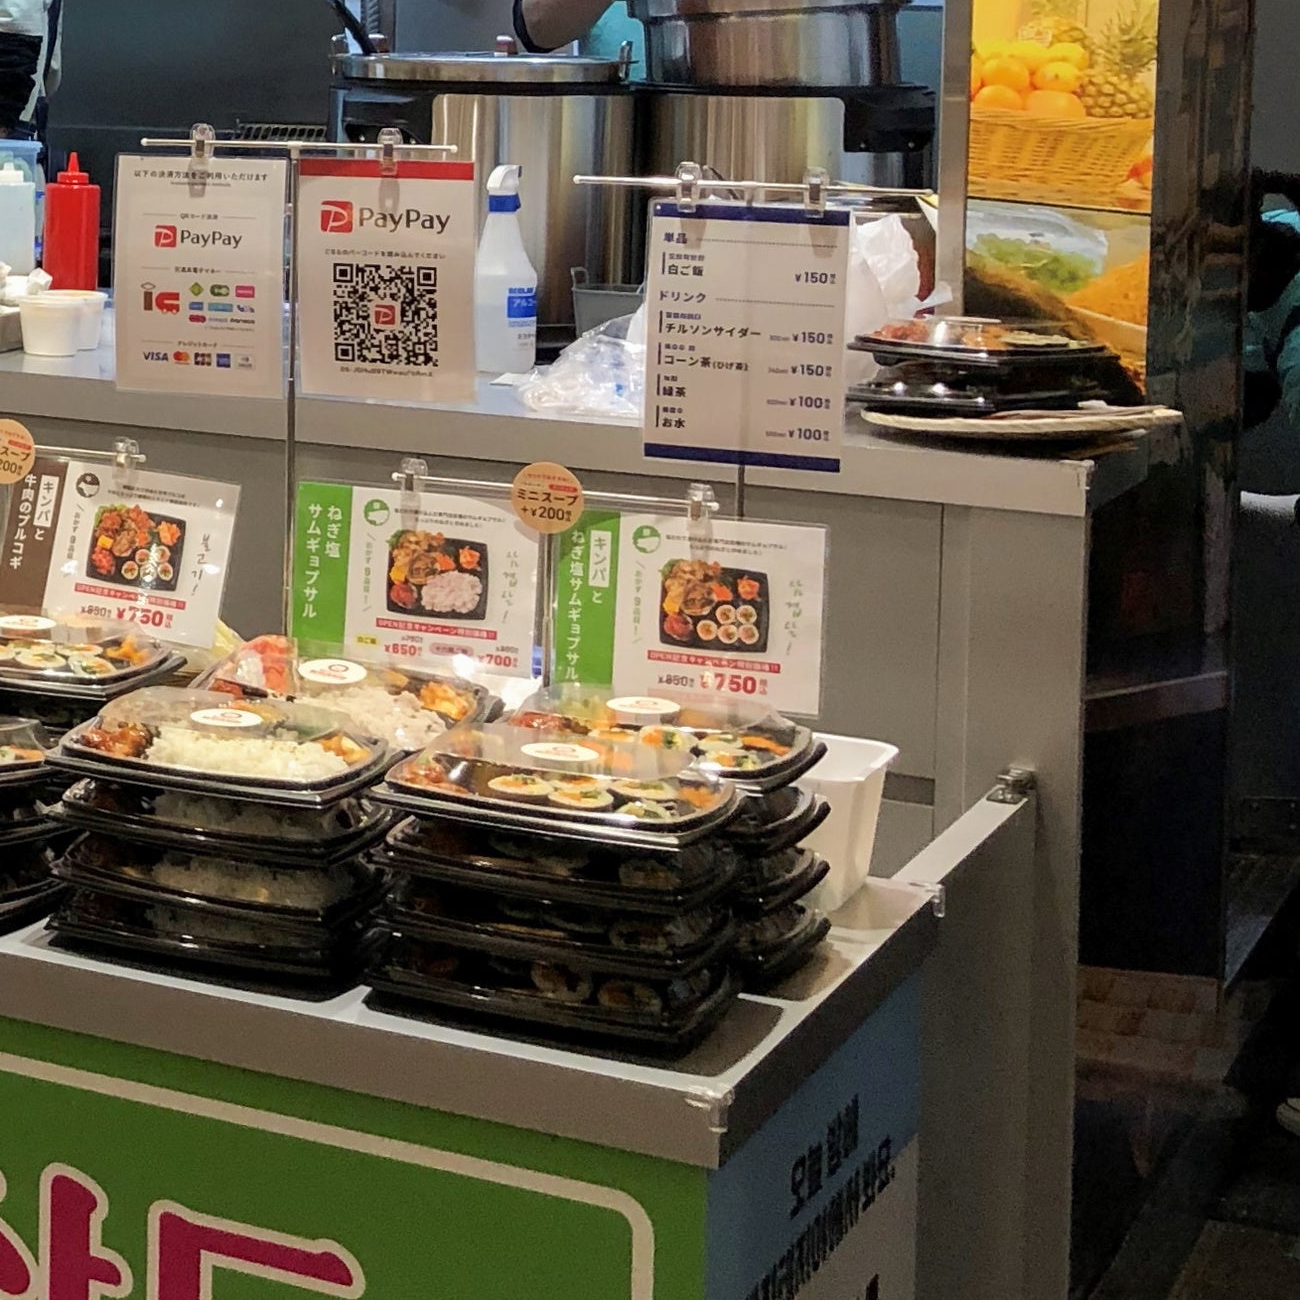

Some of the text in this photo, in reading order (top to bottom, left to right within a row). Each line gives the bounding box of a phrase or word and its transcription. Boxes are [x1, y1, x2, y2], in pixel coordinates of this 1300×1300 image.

[358, 208, 451, 235] PayPay
[180, 229, 242, 249] PayPay
[663, 231, 688, 245] 単品
[667, 264, 828, 285] 白ご飯 ¥150
[659, 290, 706, 304] ドリンク
[665, 322, 825, 345] チルソンサイダー ¥150
[143, 352, 169, 362] VISA
[791, 364, 824, 378] ¥150
[663, 386, 823, 410] 緑茶 ¥100
[662, 416, 822, 441] お水 ¥100
[517, 488, 579, 506] ミニスープ
[34, 481, 56, 541] キンパと
[325, 506, 343, 558] ねぎ塩
[302, 503, 323, 619] サムギョプサル
[591, 537, 609, 605] キンパと
[116, 606, 163, 628] ¥750
